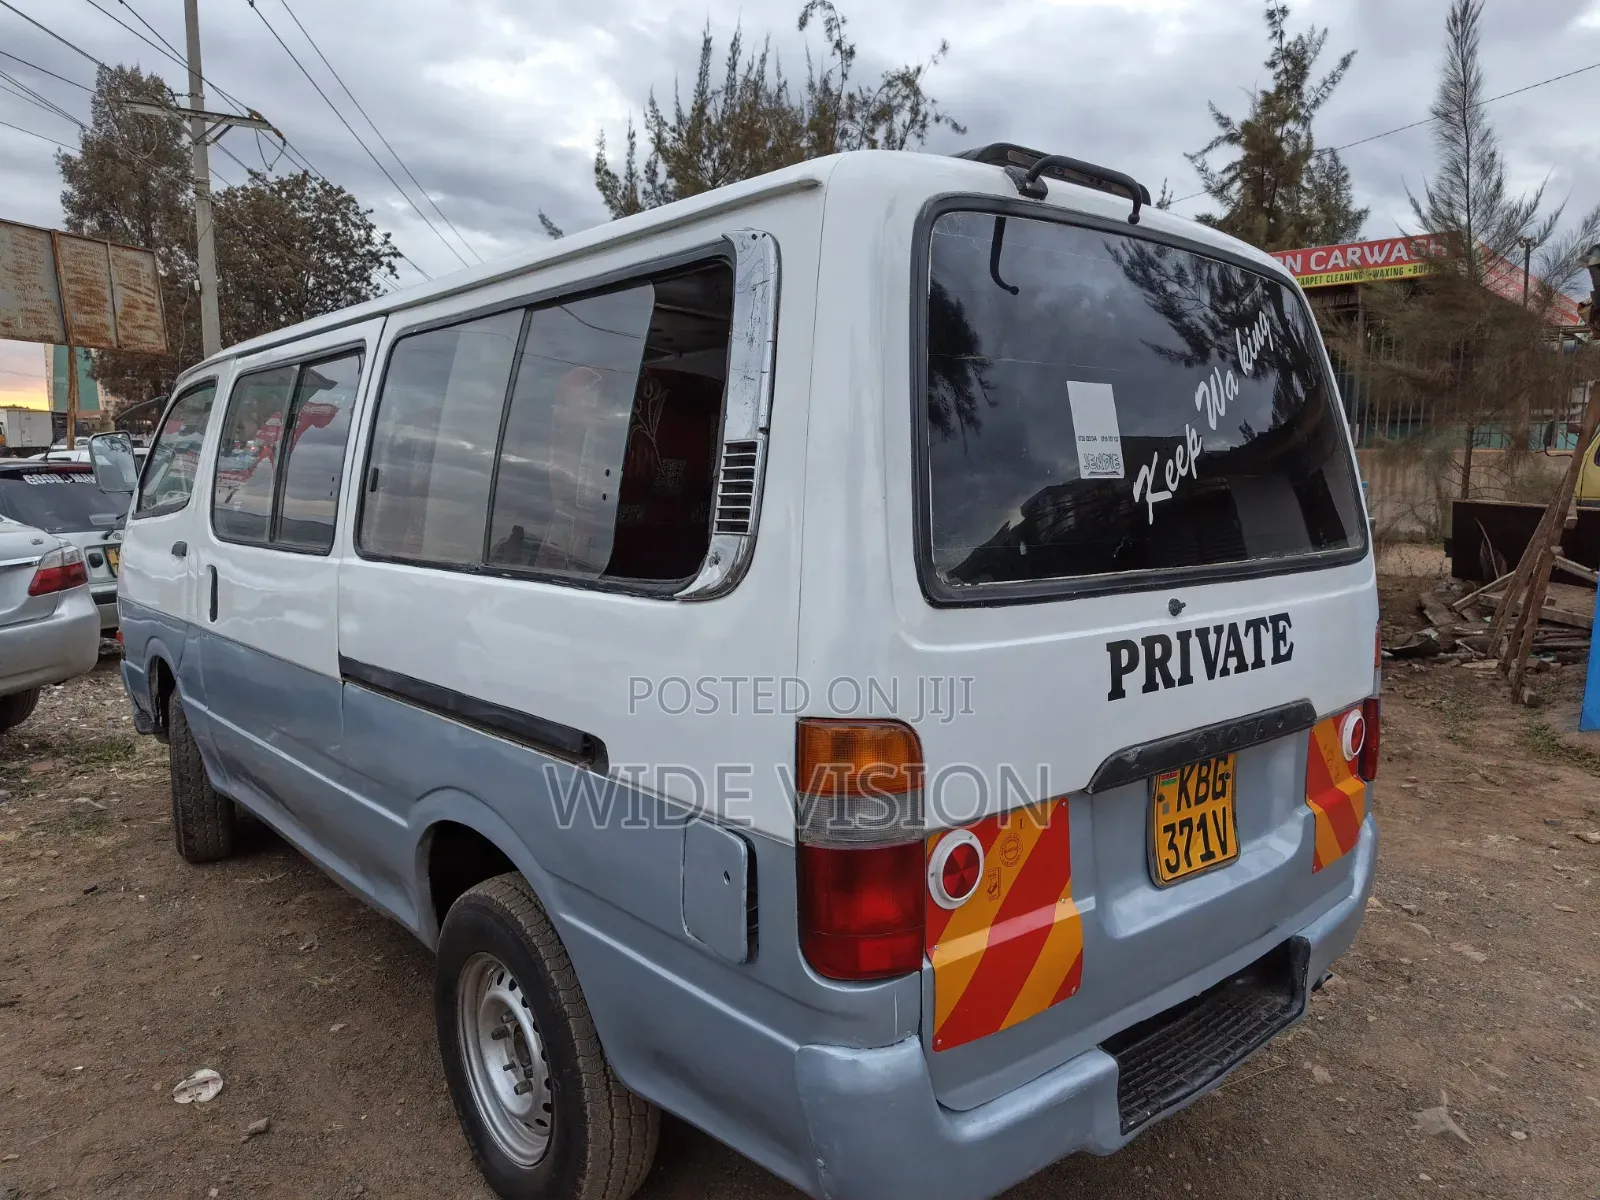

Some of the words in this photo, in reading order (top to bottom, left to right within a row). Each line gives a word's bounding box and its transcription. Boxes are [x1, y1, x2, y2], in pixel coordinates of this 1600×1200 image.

[1310, 237, 1449, 269] CARWASH
[1325, 270, 1364, 284] CLEANING
[1373, 266, 1404, 278] WAXING
[1132, 423, 1202, 525] Keep
[1105, 611, 1295, 702] PRIVATE
[1176, 755, 1231, 813] KBG
[1162, 806, 1228, 874] 371V
